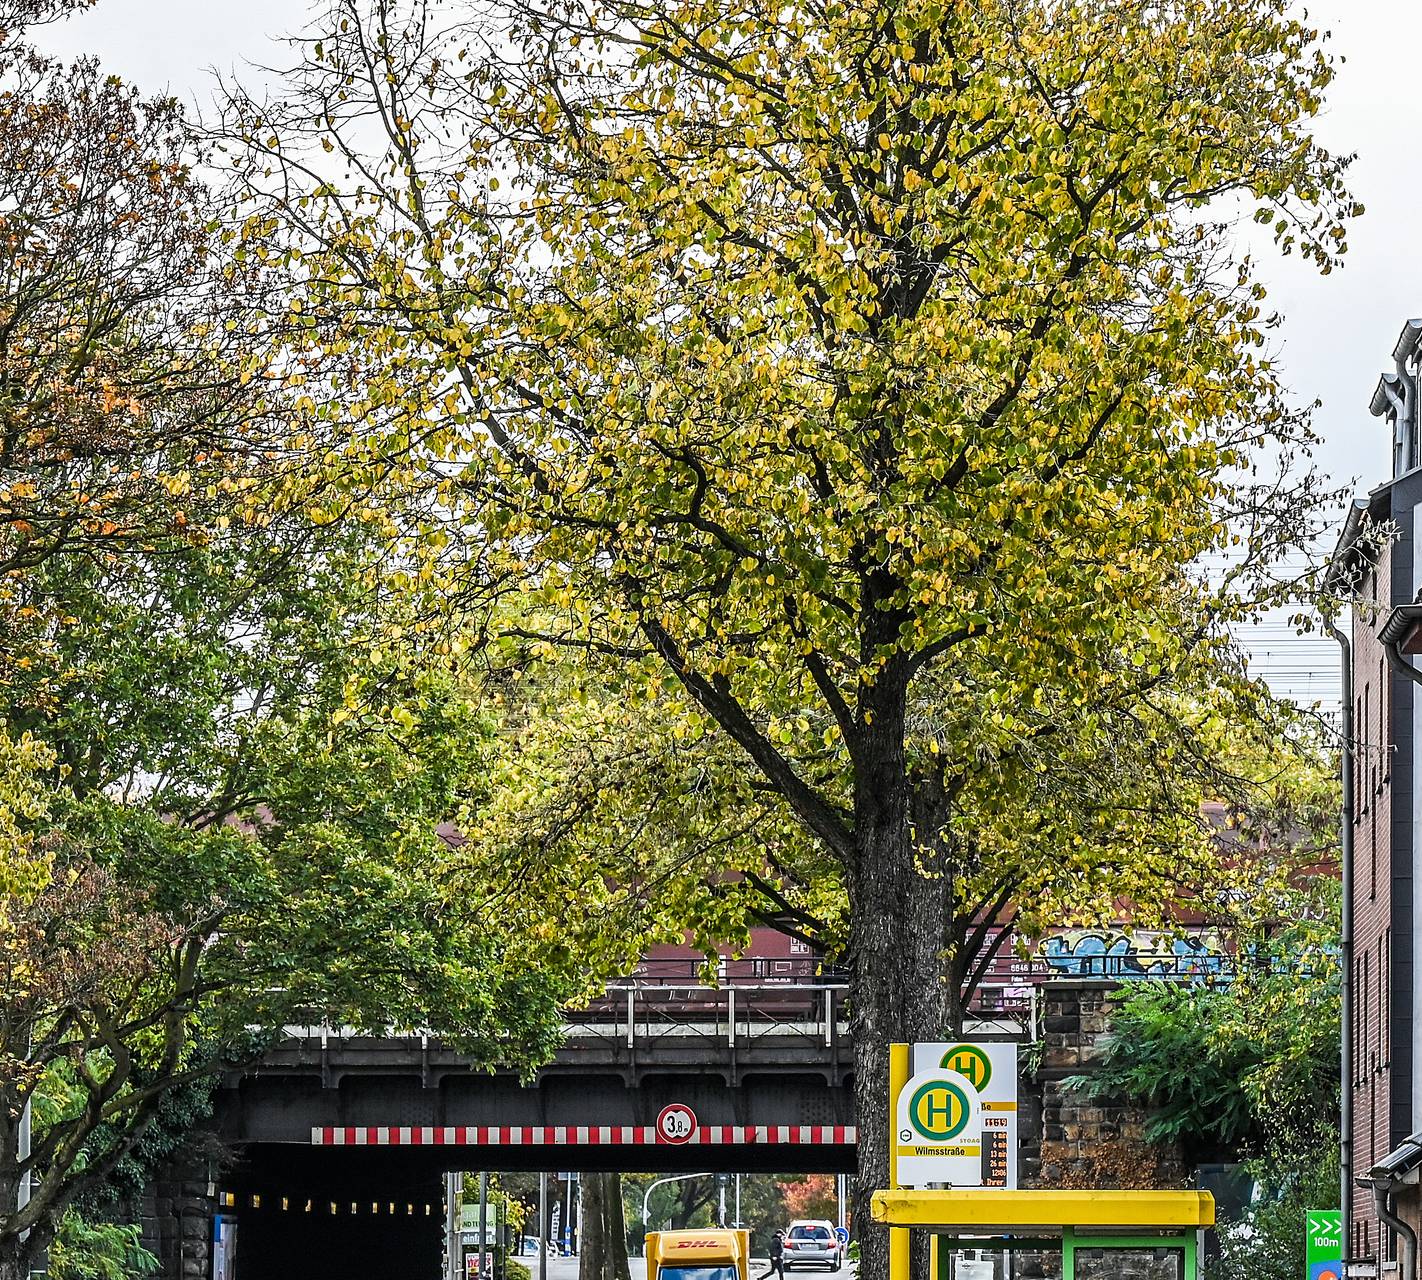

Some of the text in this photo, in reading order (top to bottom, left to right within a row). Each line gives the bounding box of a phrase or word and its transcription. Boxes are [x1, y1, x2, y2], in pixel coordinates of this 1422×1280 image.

[915, 1146, 965, 1156] Wilmsstraße
[677, 1240, 719, 1248] DHL
[1314, 1237, 1338, 1247] 100m
